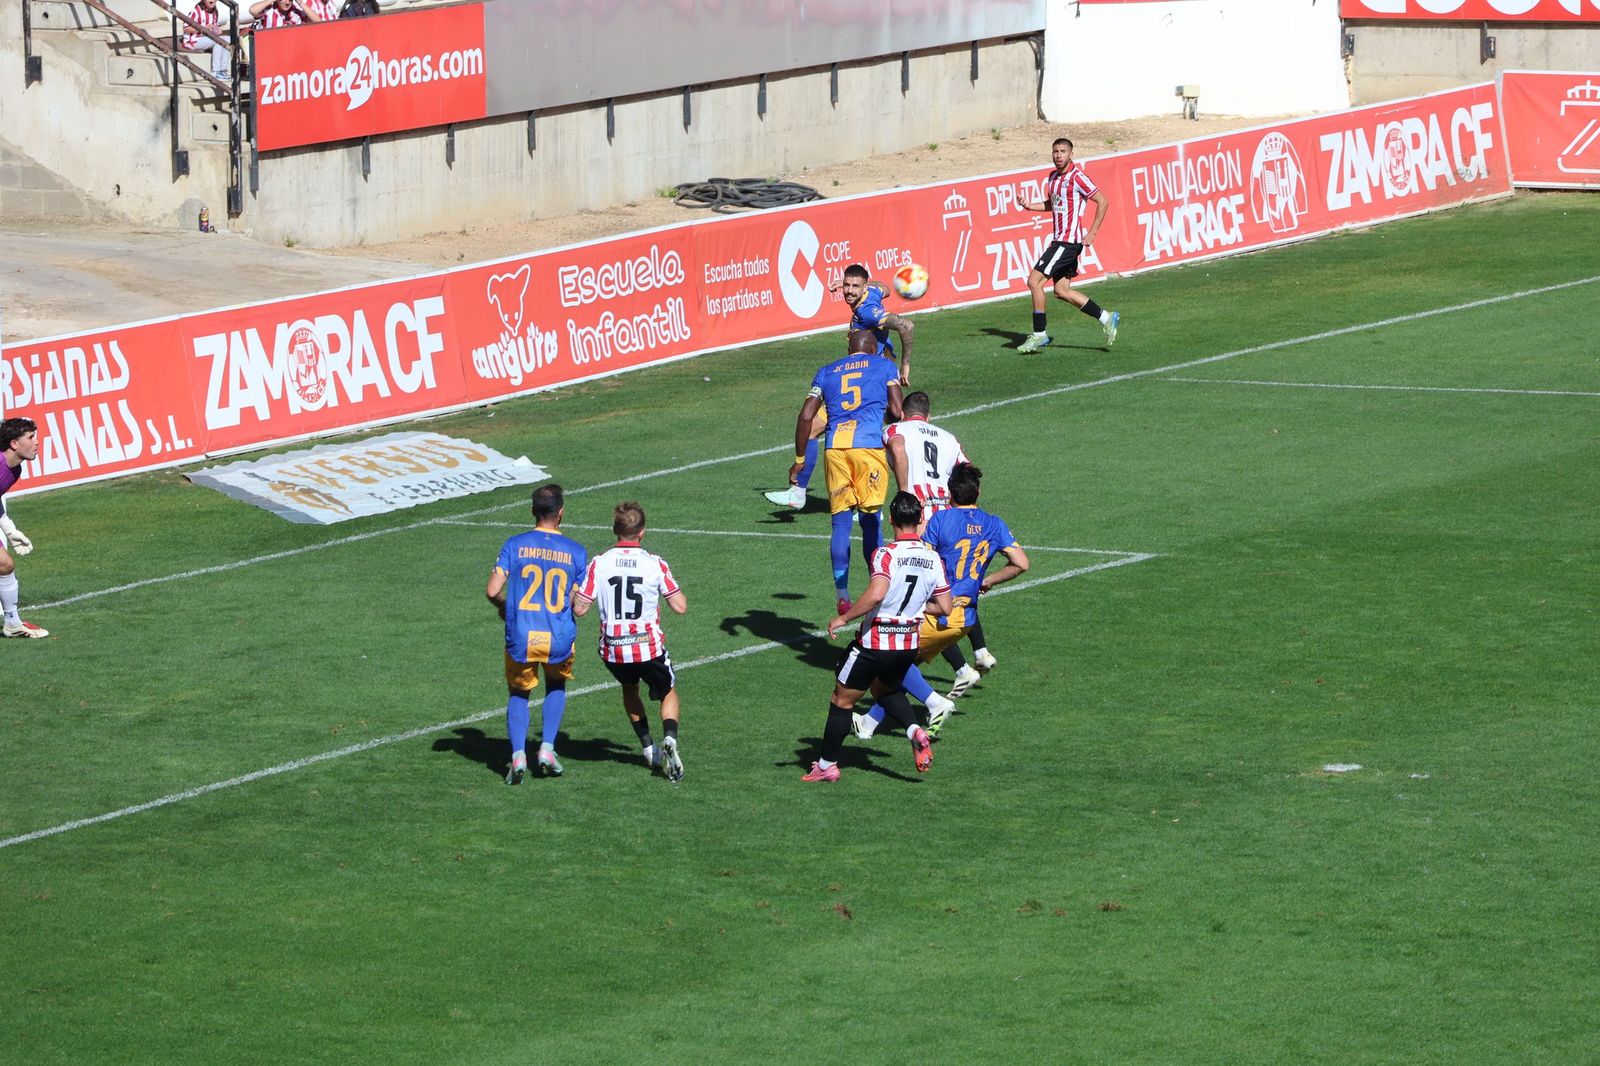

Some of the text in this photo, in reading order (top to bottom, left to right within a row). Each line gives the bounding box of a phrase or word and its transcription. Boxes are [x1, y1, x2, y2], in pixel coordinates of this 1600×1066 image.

[261, 46, 483, 110] zamora24horas.com
[1132, 142, 1243, 208] FUNDACIÓN
[1319, 102, 1493, 212] ZAMORA CF
[704, 255, 770, 284] Escucha todos
[823, 240, 852, 264] COPE
[875, 247, 912, 271] COPE.es
[985, 228, 1104, 291] ZAMA
[558, 244, 685, 308] Escuela
[706, 289, 774, 319] los partidos en
[566, 297, 691, 365] infantil
[193, 295, 445, 431] ZAMORA CF
[840, 372, 863, 411] 5
[20, 399, 143, 480] ANAS
[923, 440, 940, 480] 9
[518, 547, 574, 566] CAMPABADAL
[615, 558, 638, 569] LOREN
[954, 538, 990, 580] 18
[518, 564, 568, 614] 20
[607, 575, 644, 621] 15
[896, 574, 919, 617] 7
